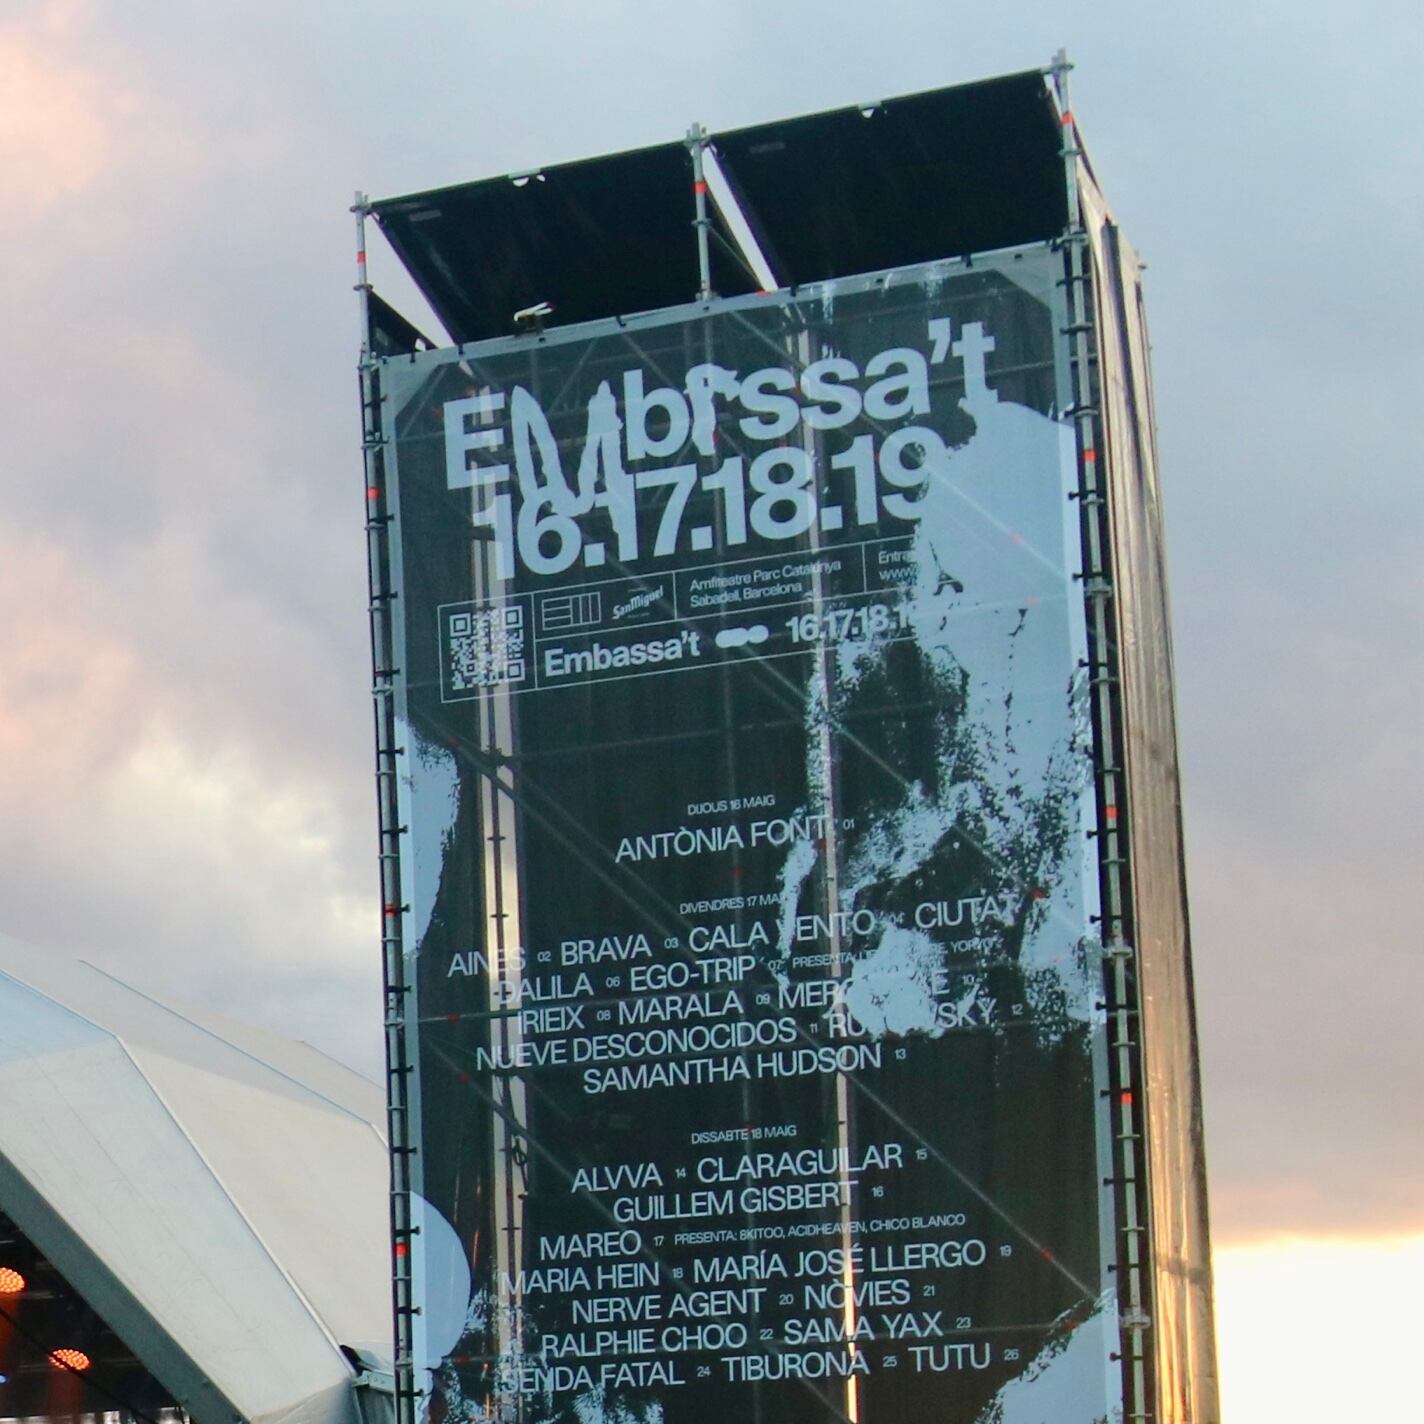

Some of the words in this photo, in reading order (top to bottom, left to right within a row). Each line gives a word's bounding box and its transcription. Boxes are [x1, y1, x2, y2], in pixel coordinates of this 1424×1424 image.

[473, 426, 948, 580] 16.17.18.19
[689, 574, 752, 592] Amfiteatre
[753, 570, 781, 584] Parc
[782, 560, 842, 578] Catalunya
[743, 581, 802, 600] Barcelona
[544, 629, 701, 677] Embassa't
[687, 799, 728, 816] DIJOUS
[743, 794, 776, 810] MAIG
[614, 824, 745, 863] ANTÒNIA
[750, 815, 831, 849] FONT
[679, 895, 745, 914] DIVENDRES
[746, 895, 758, 907] 17
[447, 947, 527, 978] AINES
[537, 950, 552, 963] 02
[560, 933, 652, 966] BRAVA
[664, 937, 679, 949] 03
[688, 920, 770, 953] CALA
[914, 893, 1018, 930] CIUTAT
[499, 973, 595, 1004] DALILA
[605, 976, 621, 988] 06
[630, 955, 757, 993] EGO-TRIP
[518, 1004, 585, 1036] IRIEIX
[597, 1009, 612, 1022] 08
[618, 990, 745, 1026] MARALA
[755, 993, 771, 1006] 09
[476, 1039, 567, 1072] NUEVE
[573, 1017, 797, 1063] DESCONOCIDOS
[1011, 1003, 1024, 1016] 12
[583, 1055, 752, 1095] SAMANTHA
[757, 1042, 881, 1080] HUDSON
[894, 1048, 907, 1061] 13
[691, 1128, 749, 1145] DISSABTE
[763, 1124, 798, 1140] MAIG
[570, 1162, 664, 1194] ALVVA
[675, 1167, 687, 1179] 14
[696, 1142, 904, 1184] CLARAGUILAR
[915, 1149, 928, 1161] 15
[613, 1189, 734, 1224] GUILLEM
[739, 1179, 860, 1215] GISBERT
[872, 1186, 885, 1199] 16
[539, 1229, 643, 1262] MAREO
[653, 1235, 665, 1248] 17
[674, 1231, 738, 1246] PRESENTA:
[787, 1221, 869, 1239] ACIDHEAVEN,
[869, 1217, 910, 1232] CHICO
[911, 1213, 967, 1229] BLANCO
[501, 1266, 592, 1297] MARIA
[597, 1262, 660, 1291] HEIN
[693, 1249, 788, 1285] MARÍA
[793, 1242, 866, 1278] JOSÉ
[870, 1238, 988, 1273] LLERGO
[572, 1294, 662, 1325] NERVE
[668, 1287, 768, 1319] AGENT
[779, 1294, 794, 1306] 20
[923, 1285, 936, 1297] 21
[541, 1328, 657, 1359] RALPHIE
[661, 1322, 749, 1353] CHOO
[759, 1328, 774, 1340] 22
[783, 1315, 876, 1346] SAMA
[881, 1310, 945, 1340] YAX
[956, 1317, 972, 1330] 23
[501, 1364, 595, 1395] SENDA
[599, 1360, 686, 1389] FATAL
[697, 1366, 712, 1378] 24
[720, 1350, 871, 1383] TIBURONA
[882, 1356, 898, 1368] 25
[907, 1342, 991, 1373] TUTU
[1003, 1349, 1020, 1362] 26
